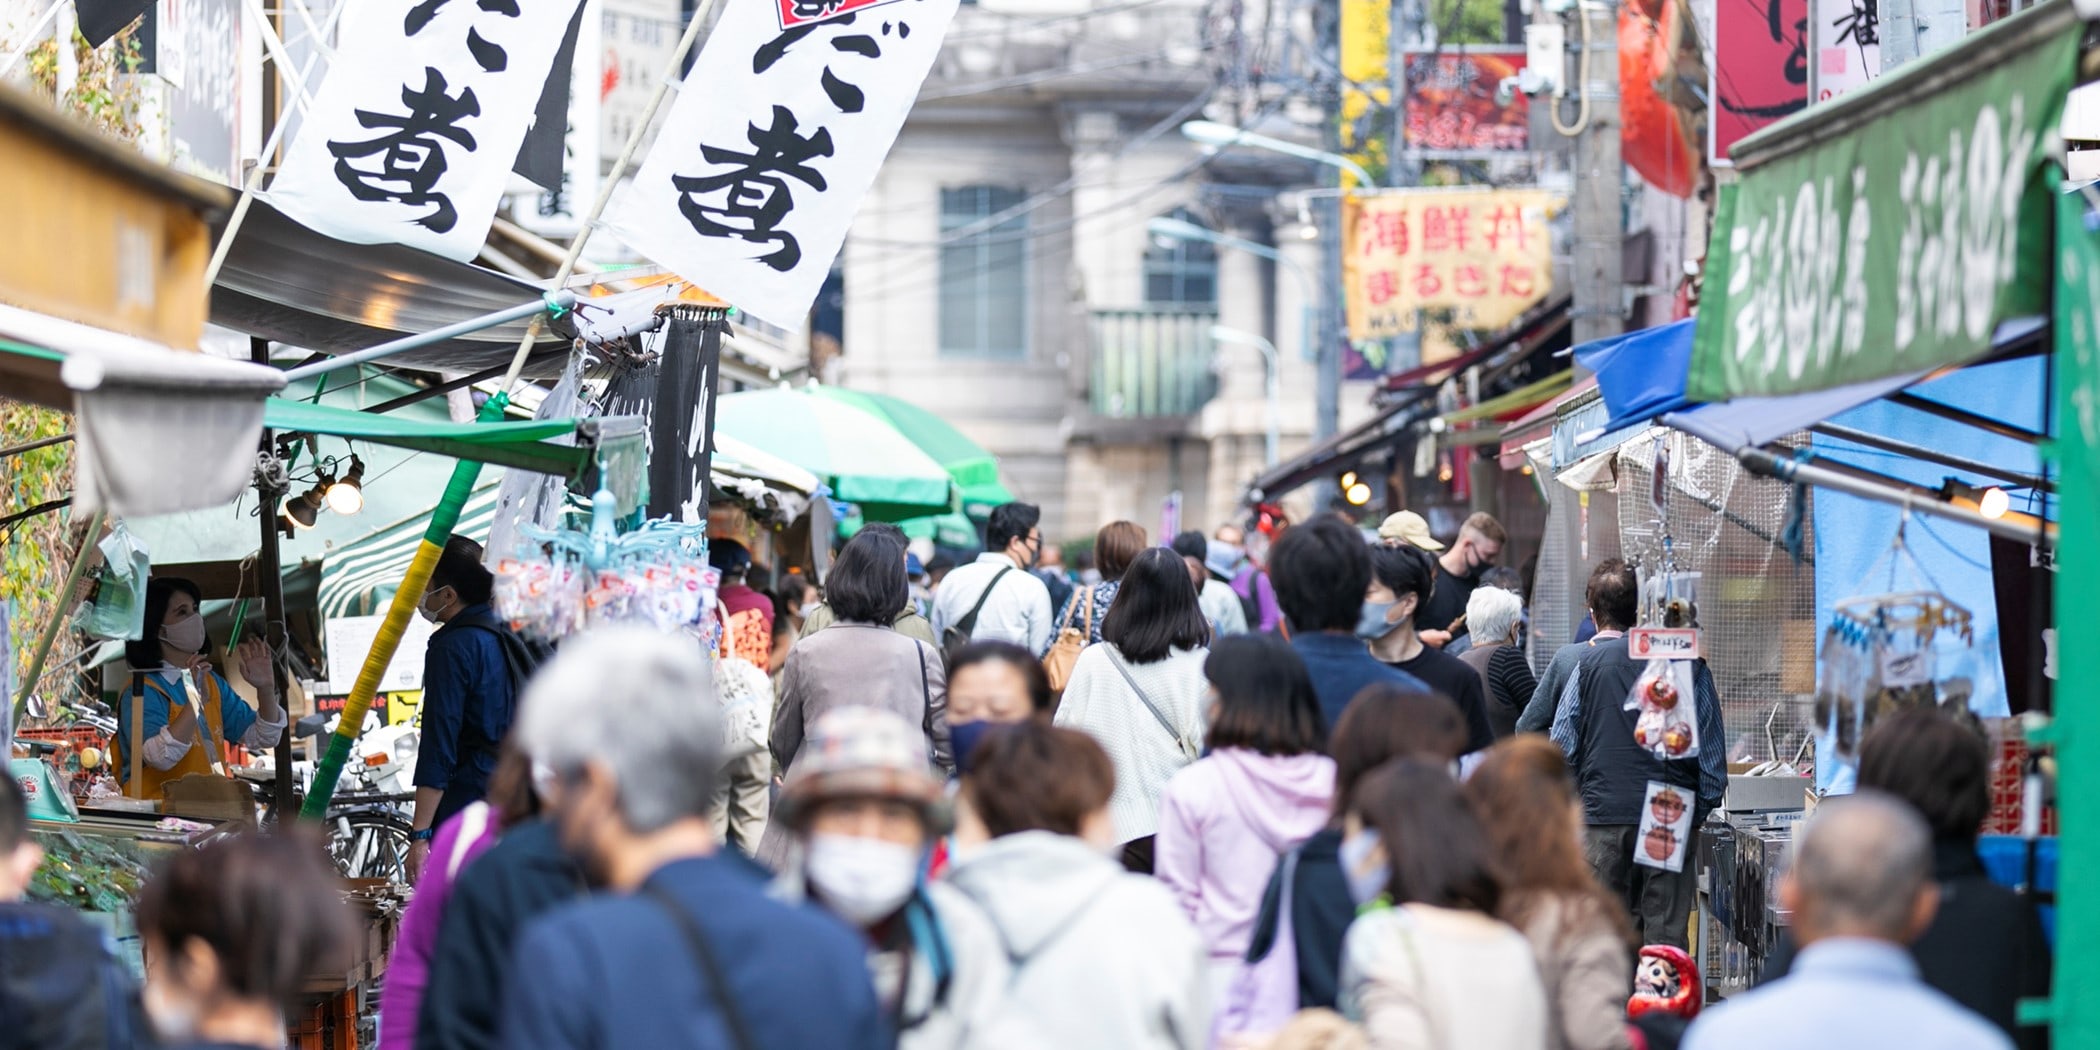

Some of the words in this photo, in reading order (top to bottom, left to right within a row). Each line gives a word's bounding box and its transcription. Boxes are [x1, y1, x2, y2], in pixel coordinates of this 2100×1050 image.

[1361, 205, 1533, 255] 海鮮丼
[1367, 264, 1533, 304] まるきた
